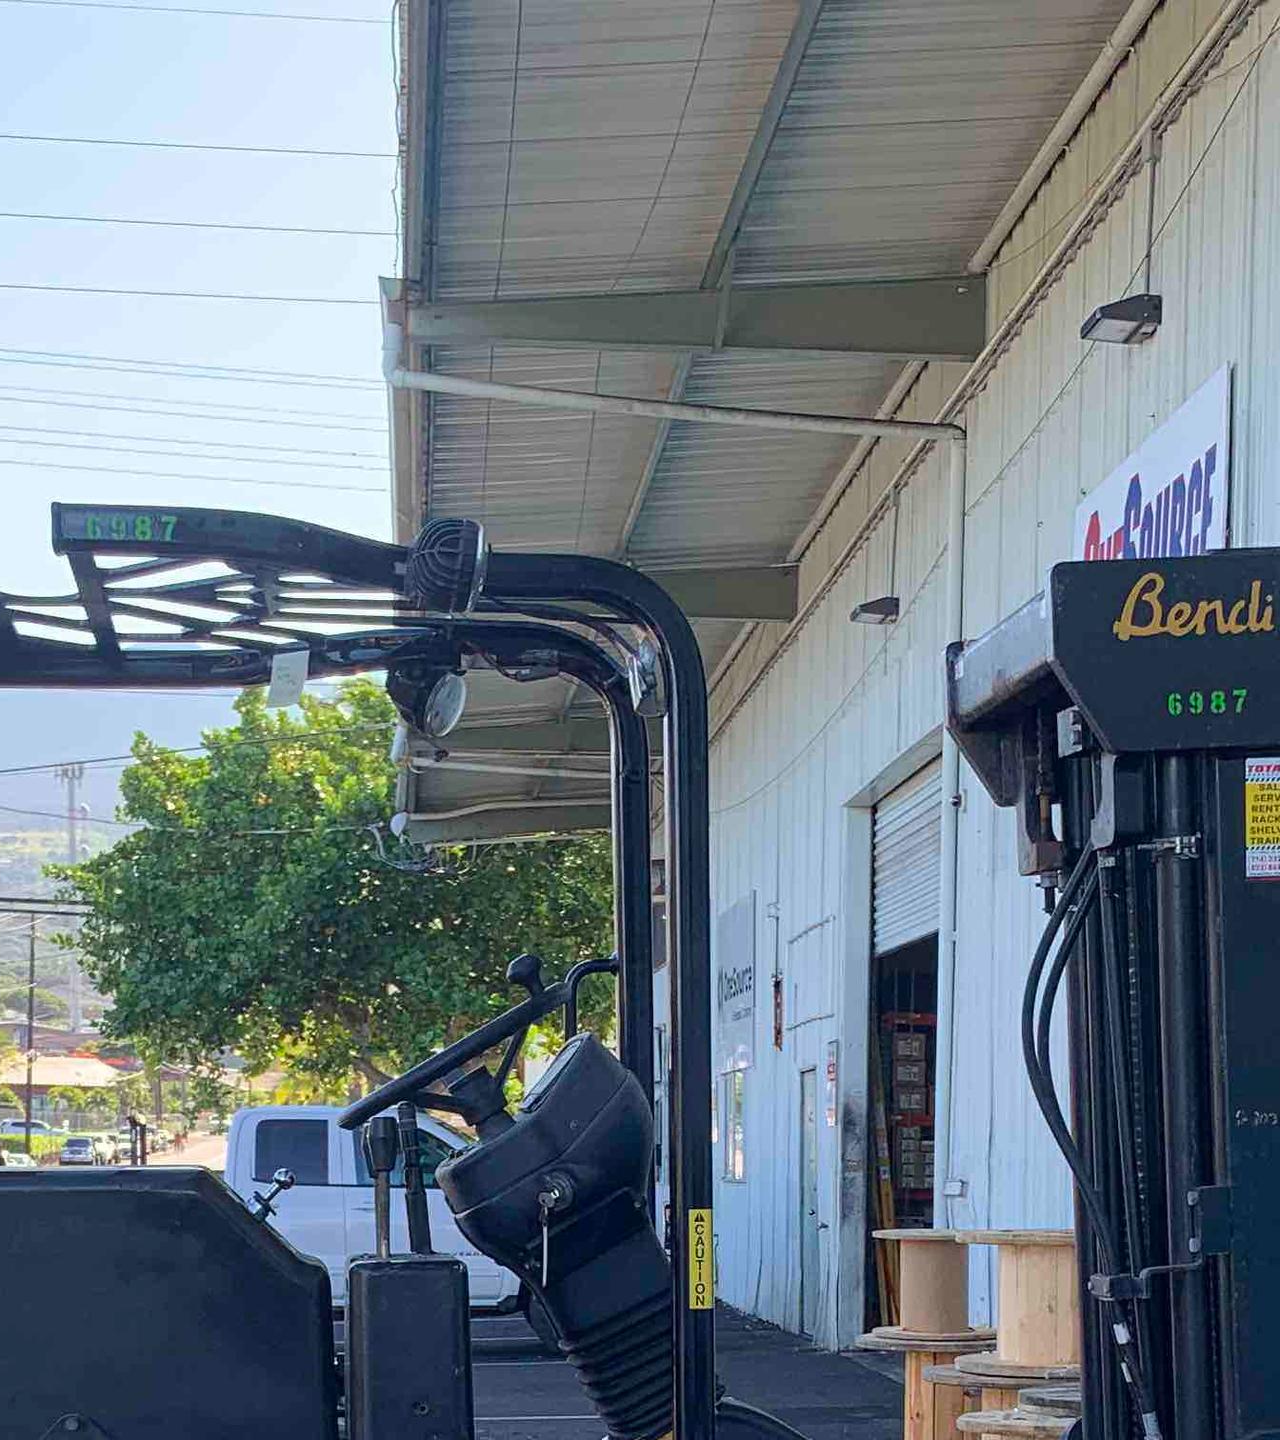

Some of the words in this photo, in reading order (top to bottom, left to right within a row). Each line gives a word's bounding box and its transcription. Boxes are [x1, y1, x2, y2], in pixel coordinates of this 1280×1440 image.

[86, 516, 177, 540] 6987
[1113, 572, 1275, 640] Bendi
[1168, 689, 1248, 716] 6987
[695, 1223, 706, 1307] CAUTION
